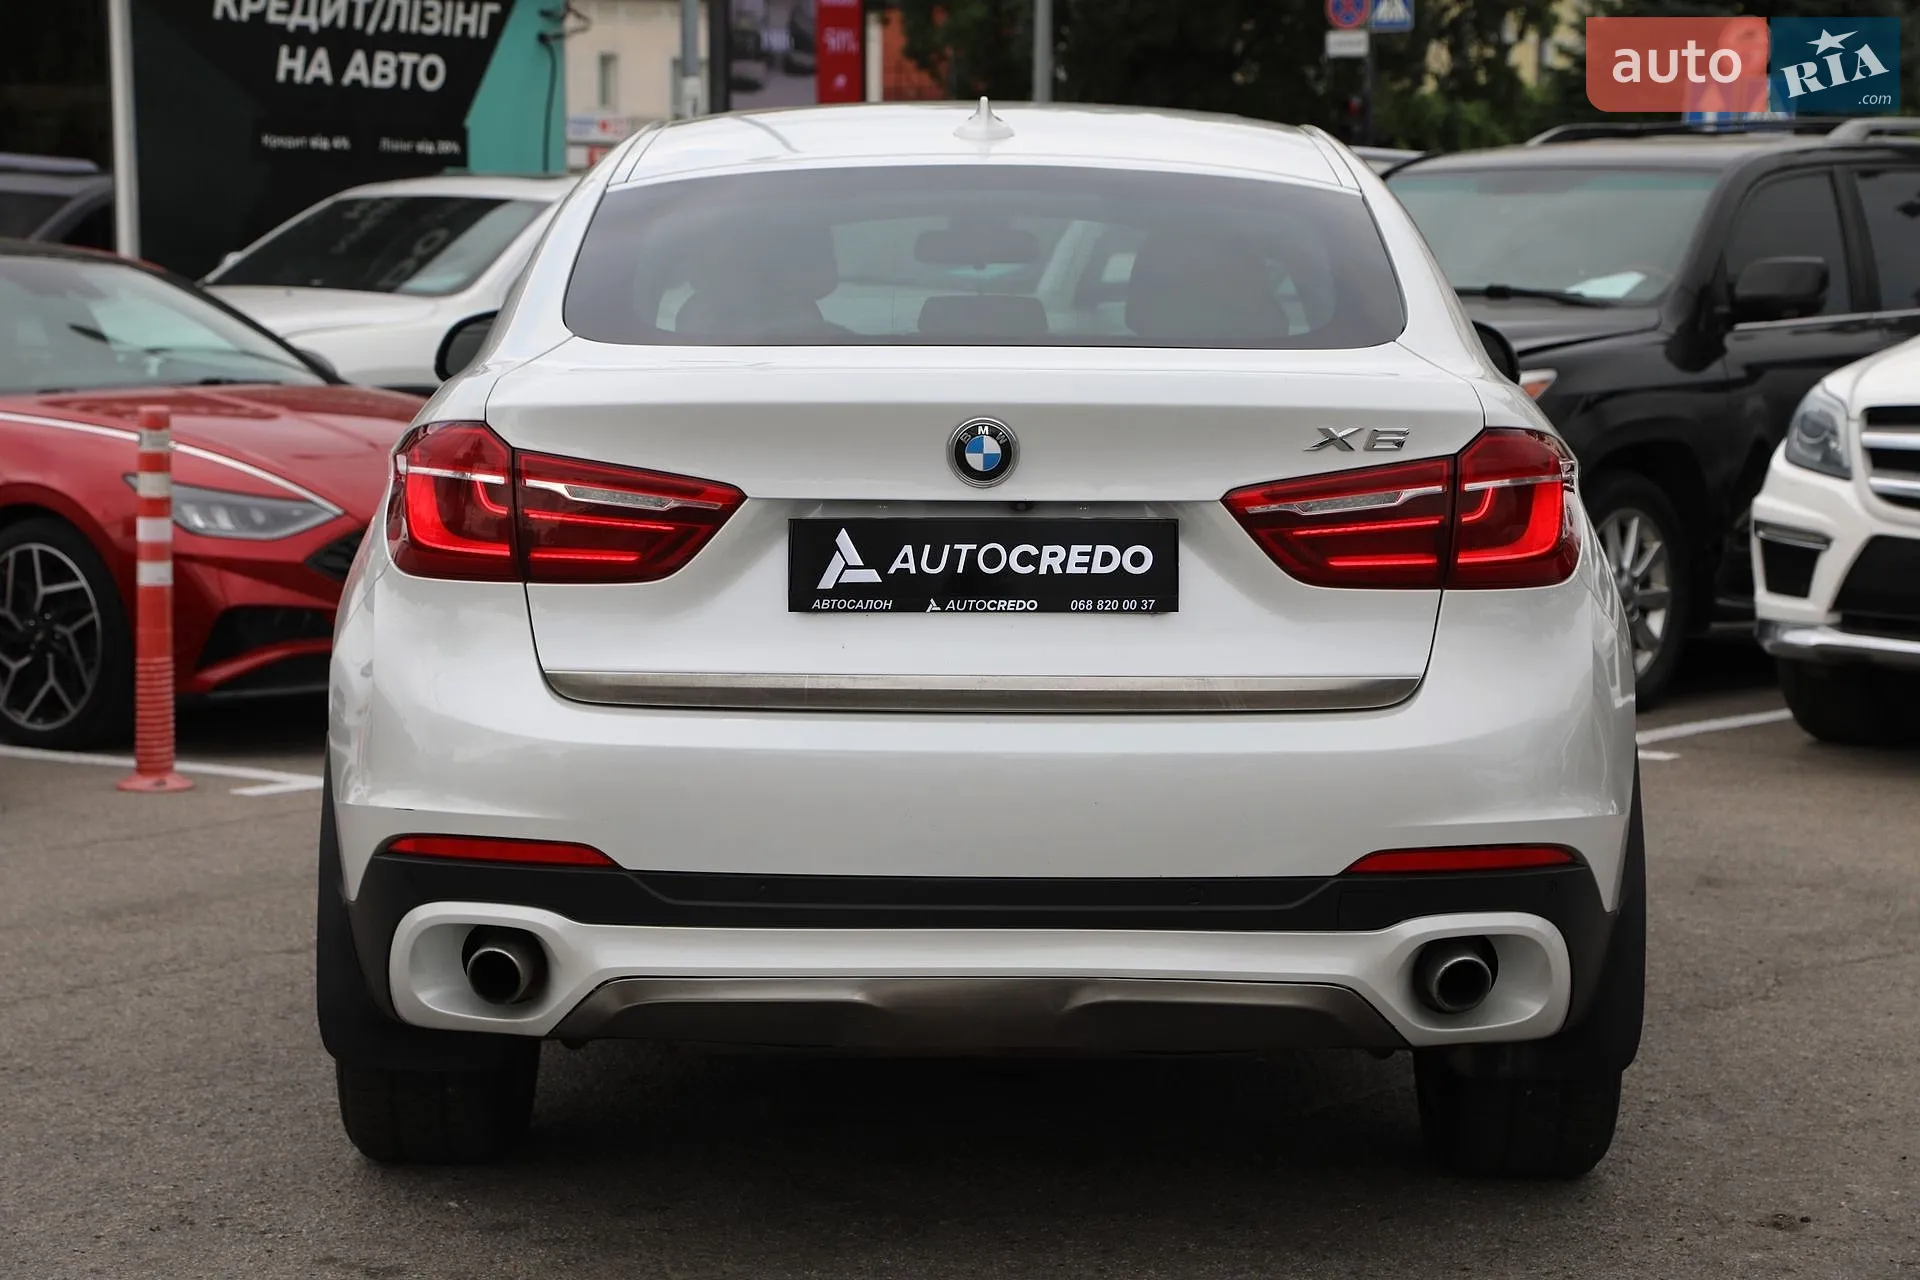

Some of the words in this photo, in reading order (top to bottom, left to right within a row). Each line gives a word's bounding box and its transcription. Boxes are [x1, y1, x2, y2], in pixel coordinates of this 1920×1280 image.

[275, 44, 333, 86] НА
[341, 48, 447, 92] АВТО
[960, 425, 1008, 445] BMW
[1303, 427, 1410, 452] X6
[887, 542, 1154, 576] AUTOCREDO
[811, 599, 893, 610] АВТОСАЛОН
[945, 599, 1039, 612] AUTOCREDO
[1070, 599, 1093, 611] 068
[1096, 599, 1119, 611] 820
[1122, 599, 1137, 611] 00
[1140, 599, 1156, 611] 37
